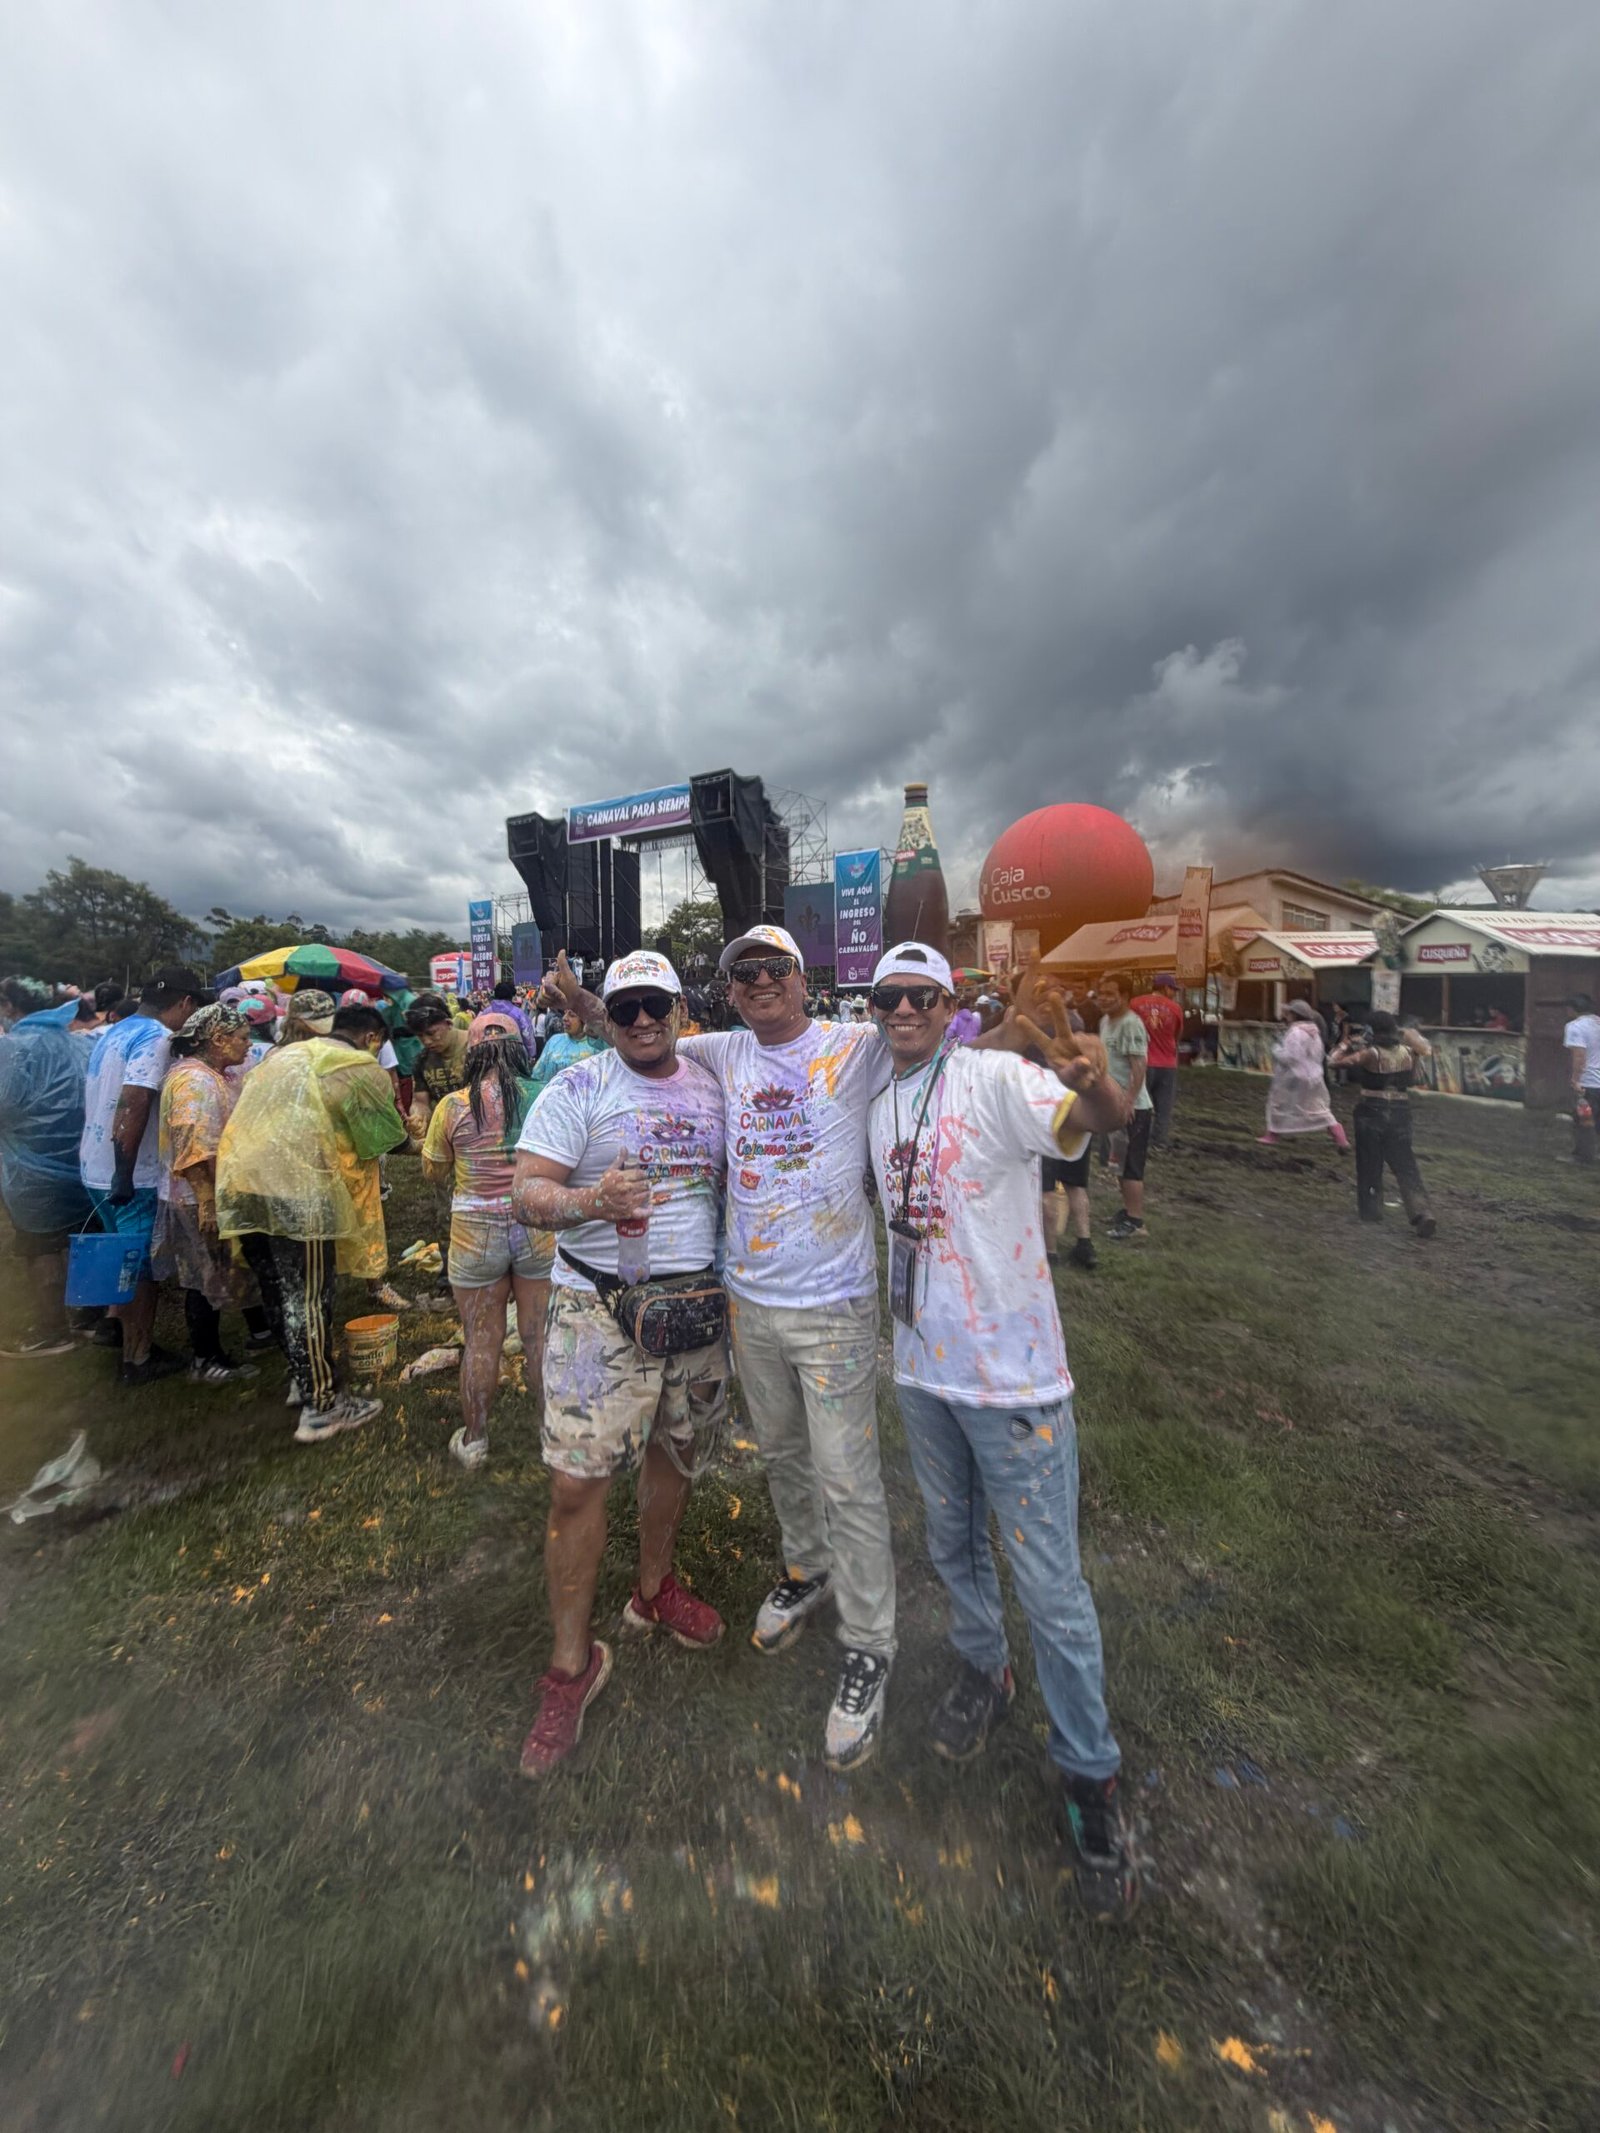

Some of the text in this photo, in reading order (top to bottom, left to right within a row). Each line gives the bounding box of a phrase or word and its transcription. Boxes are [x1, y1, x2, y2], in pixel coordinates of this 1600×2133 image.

[587, 795, 690, 827] CARNAVAL PARA SIEMPR
[991, 867, 1024, 886] Caja
[841, 883, 872, 897] VIVE AQUÍ
[992, 885, 1051, 905] Cusco
[840, 907, 875, 920] INGRESO
[472, 933, 491, 943] FIESTA
[851, 929, 867, 944] ÑO
[838, 943, 879, 954] CARNAVALÓN
[1421, 945, 1468, 960] CUSQUEÑA
[473, 952, 492, 961] ALEGRE
[476, 966, 490, 977] PERÚ
[740, 1108, 811, 1132] CARNAVAL
[785, 1131, 797, 1141] de
[639, 1144, 713, 1163] CARNAVAL
[736, 1136, 814, 1162] Cajamarca
[916, 1190, 928, 1202] de
